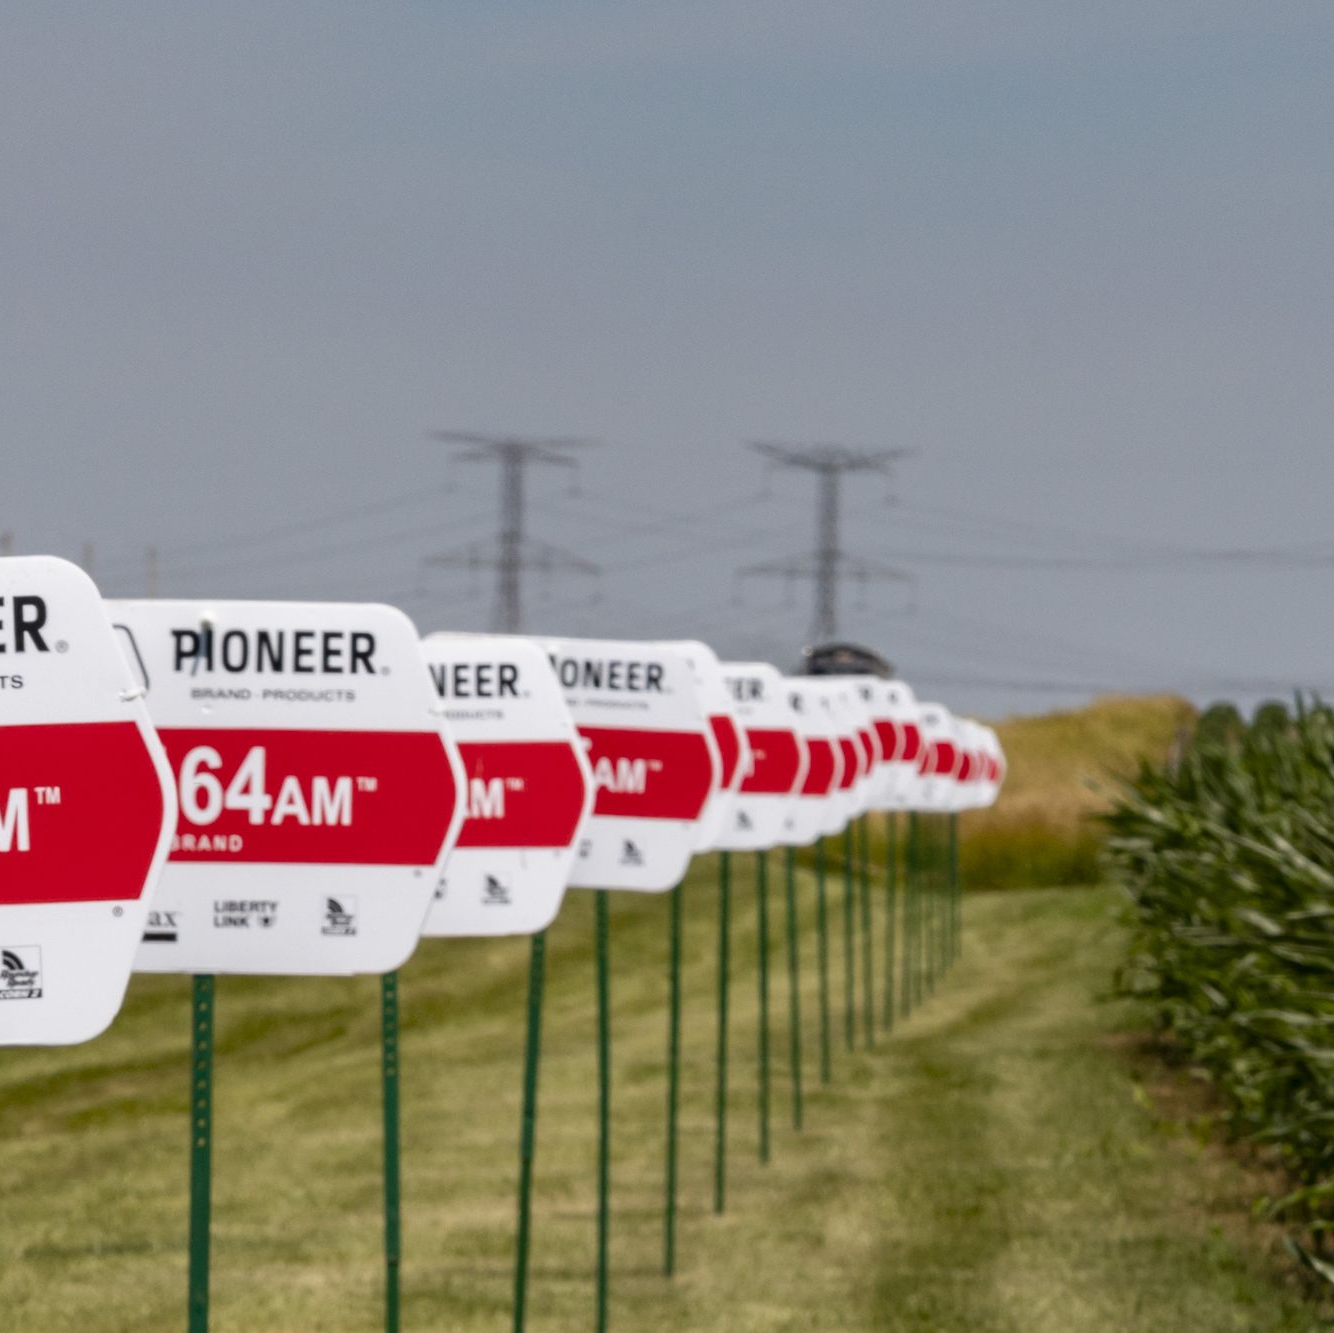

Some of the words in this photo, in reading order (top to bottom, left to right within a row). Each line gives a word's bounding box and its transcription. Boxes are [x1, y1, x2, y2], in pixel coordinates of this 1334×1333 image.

[190, 687, 252, 702] BRAND
[261, 687, 356, 703] PRODUCTS
[212, 900, 277, 915] LIBERTY
